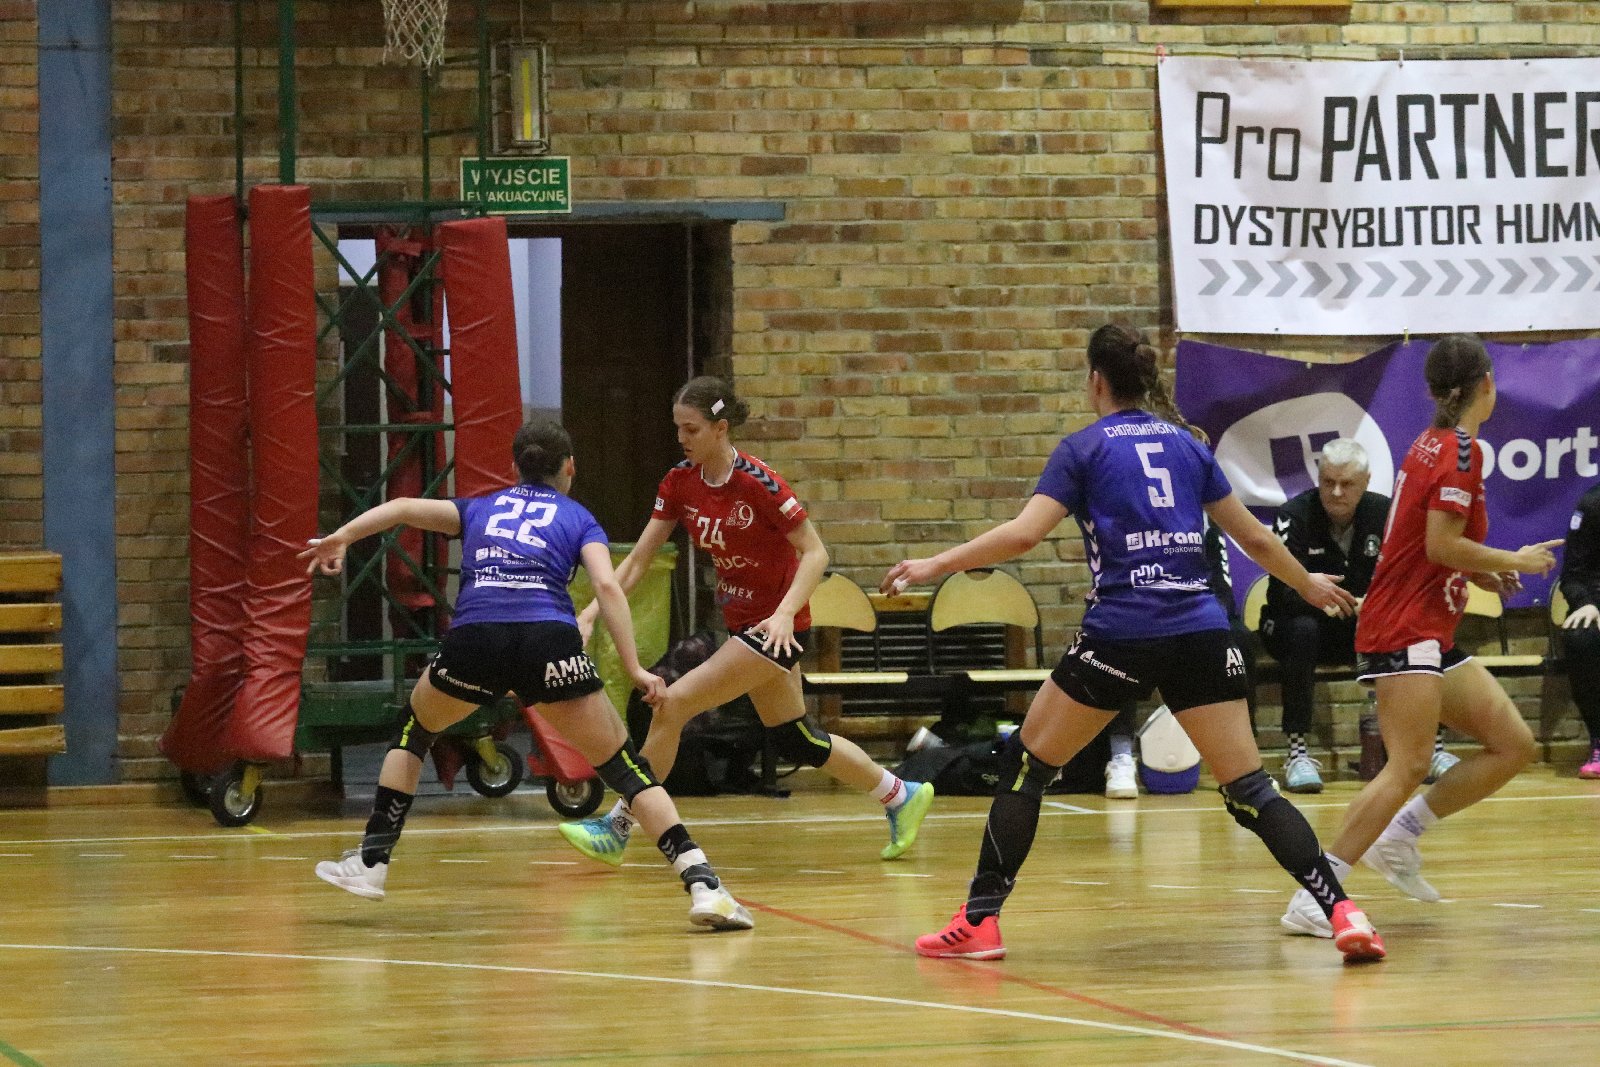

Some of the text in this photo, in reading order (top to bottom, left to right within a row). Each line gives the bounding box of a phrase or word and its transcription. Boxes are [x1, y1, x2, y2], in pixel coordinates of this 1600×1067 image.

[1195, 91, 1600, 183] Pro PARTNER
[470, 164, 561, 186] WYJŚCIE
[466, 190, 565, 203] EAKUACYJNE
[1194, 203, 1481, 249] DYSTRYBUTOR
[1134, 441, 1175, 508] 5
[484, 494, 558, 549] 22
[696, 516, 726, 551] 24
[1144, 529, 1203, 548] Kram
